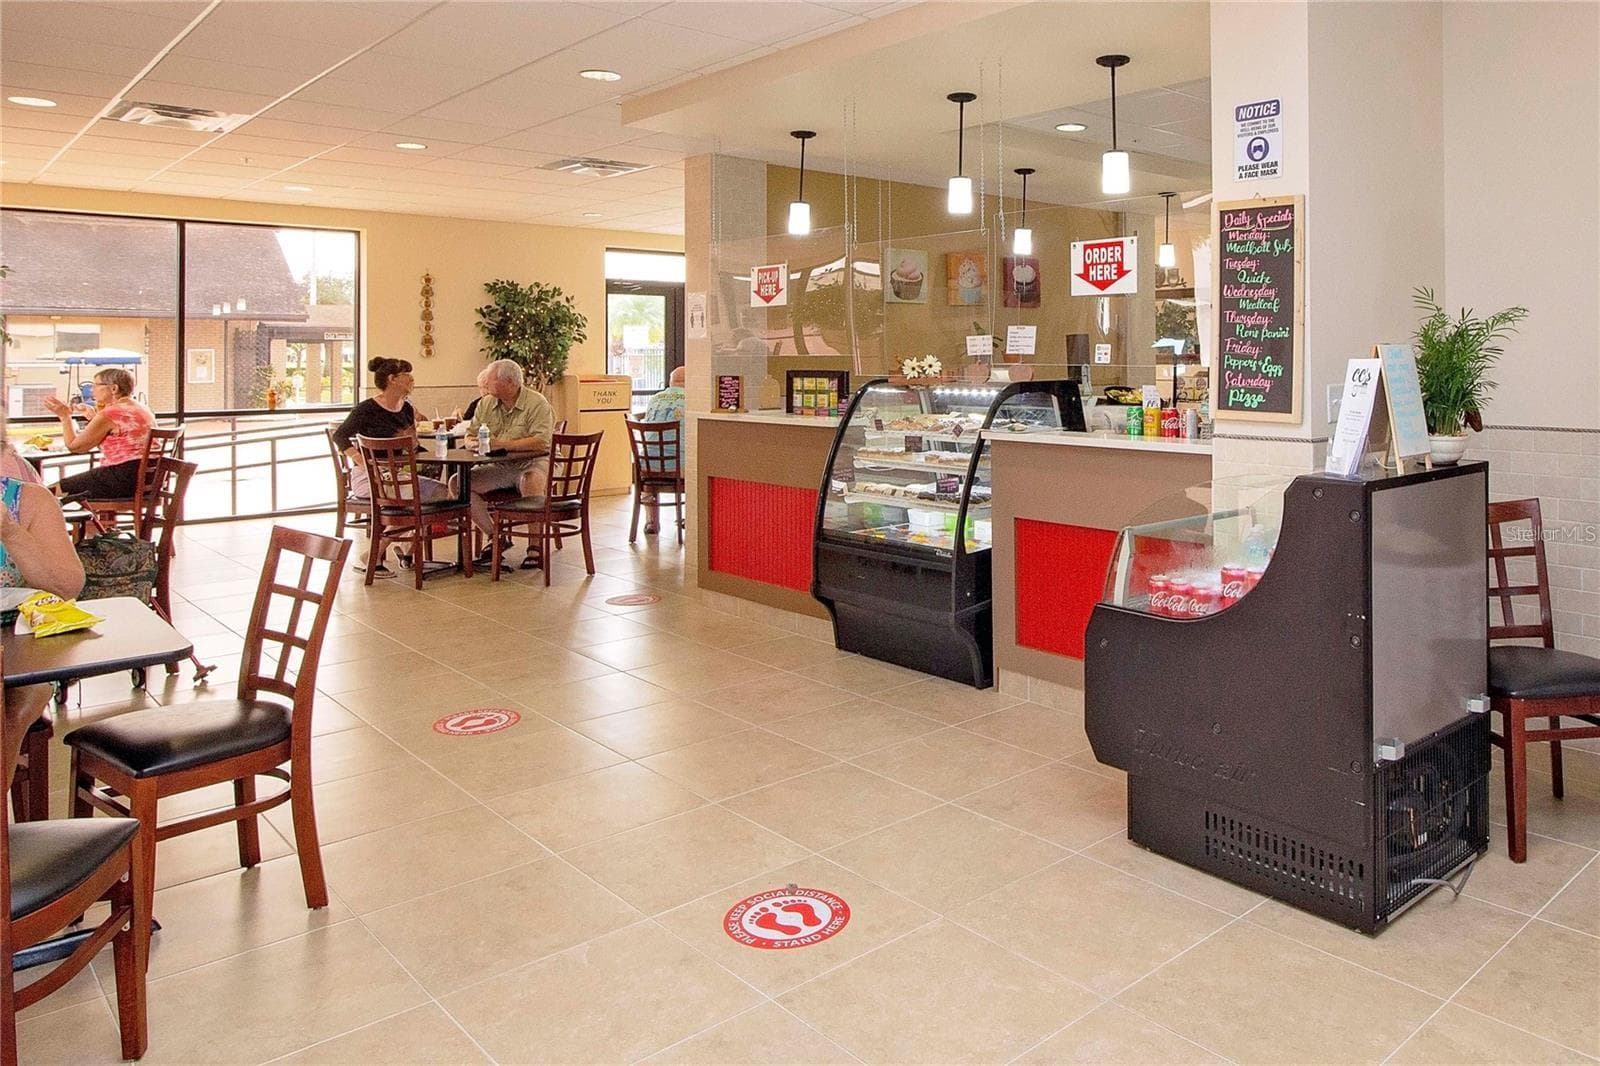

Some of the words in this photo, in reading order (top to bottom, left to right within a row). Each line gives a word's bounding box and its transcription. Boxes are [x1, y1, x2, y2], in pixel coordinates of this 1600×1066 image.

[1238, 101, 1278, 120] NOTICE
[1238, 163, 1260, 172] PLEASE
[1261, 160, 1278, 170] WEAR
[1238, 172, 1242, 180] A
[1244, 170, 1259, 179] FACE
[1260, 167, 1278, 177] MASK
[1224, 211, 1252, 229] Daily
[1255, 208, 1294, 230] Specials
[1228, 229, 1270, 243] Monday:
[1085, 246, 1122, 265] ORDER
[1225, 240, 1271, 255] Meatball
[1089, 264, 1118, 281] HERE
[1223, 256, 1260, 272] Tuesday:
[1237, 269, 1272, 284] Quiche
[760, 283, 777, 297] HERE
[1223, 283, 1278, 301] Wednesday:
[1239, 297, 1281, 313] Meatloaf
[1223, 310, 1273, 328] Thursday:
[1224, 337, 1263, 359] Friday:
[1261, 355, 1284, 377] Eggs
[1225, 370, 1274, 393] Saturday:
[1228, 388, 1266, 408] Pizza
[746, 889, 792, 905] SOCIAL
[795, 889, 844, 911] DISTANCE
[729, 904, 747, 921] KEEP
[728, 920, 754, 945] PLEASE
[772, 934, 822, 948] STAND
[822, 915, 846, 935] HERE
